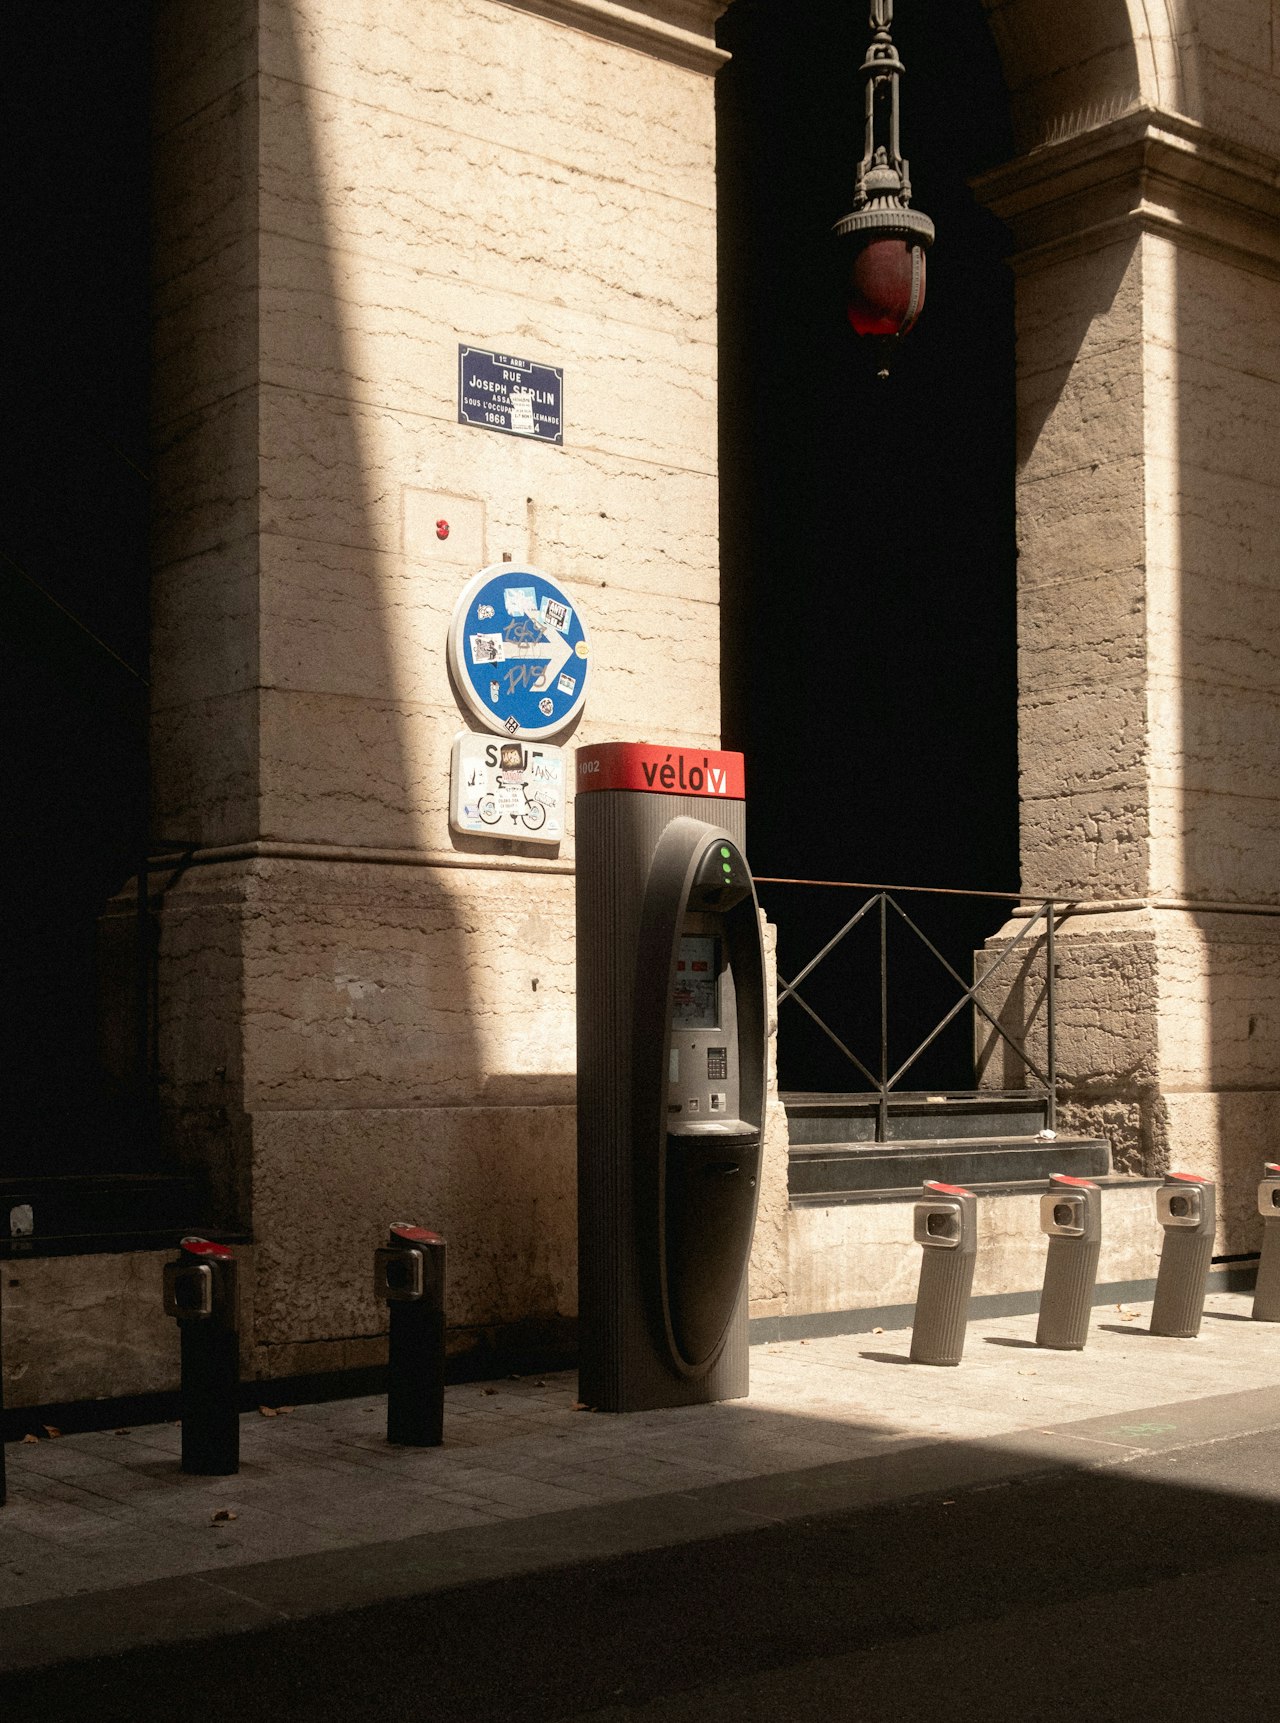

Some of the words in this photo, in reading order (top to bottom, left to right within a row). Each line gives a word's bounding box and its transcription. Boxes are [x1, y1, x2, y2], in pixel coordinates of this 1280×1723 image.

[503, 370, 522, 383] RUE
[469, 374, 507, 395] JOSEPH
[513, 385, 555, 406] SERLIN
[464, 396, 481, 407] SOUS
[533, 412, 560, 425] LEMANDE
[484, 412, 506, 425] 1868
[578, 760, 601, 776] 1002
